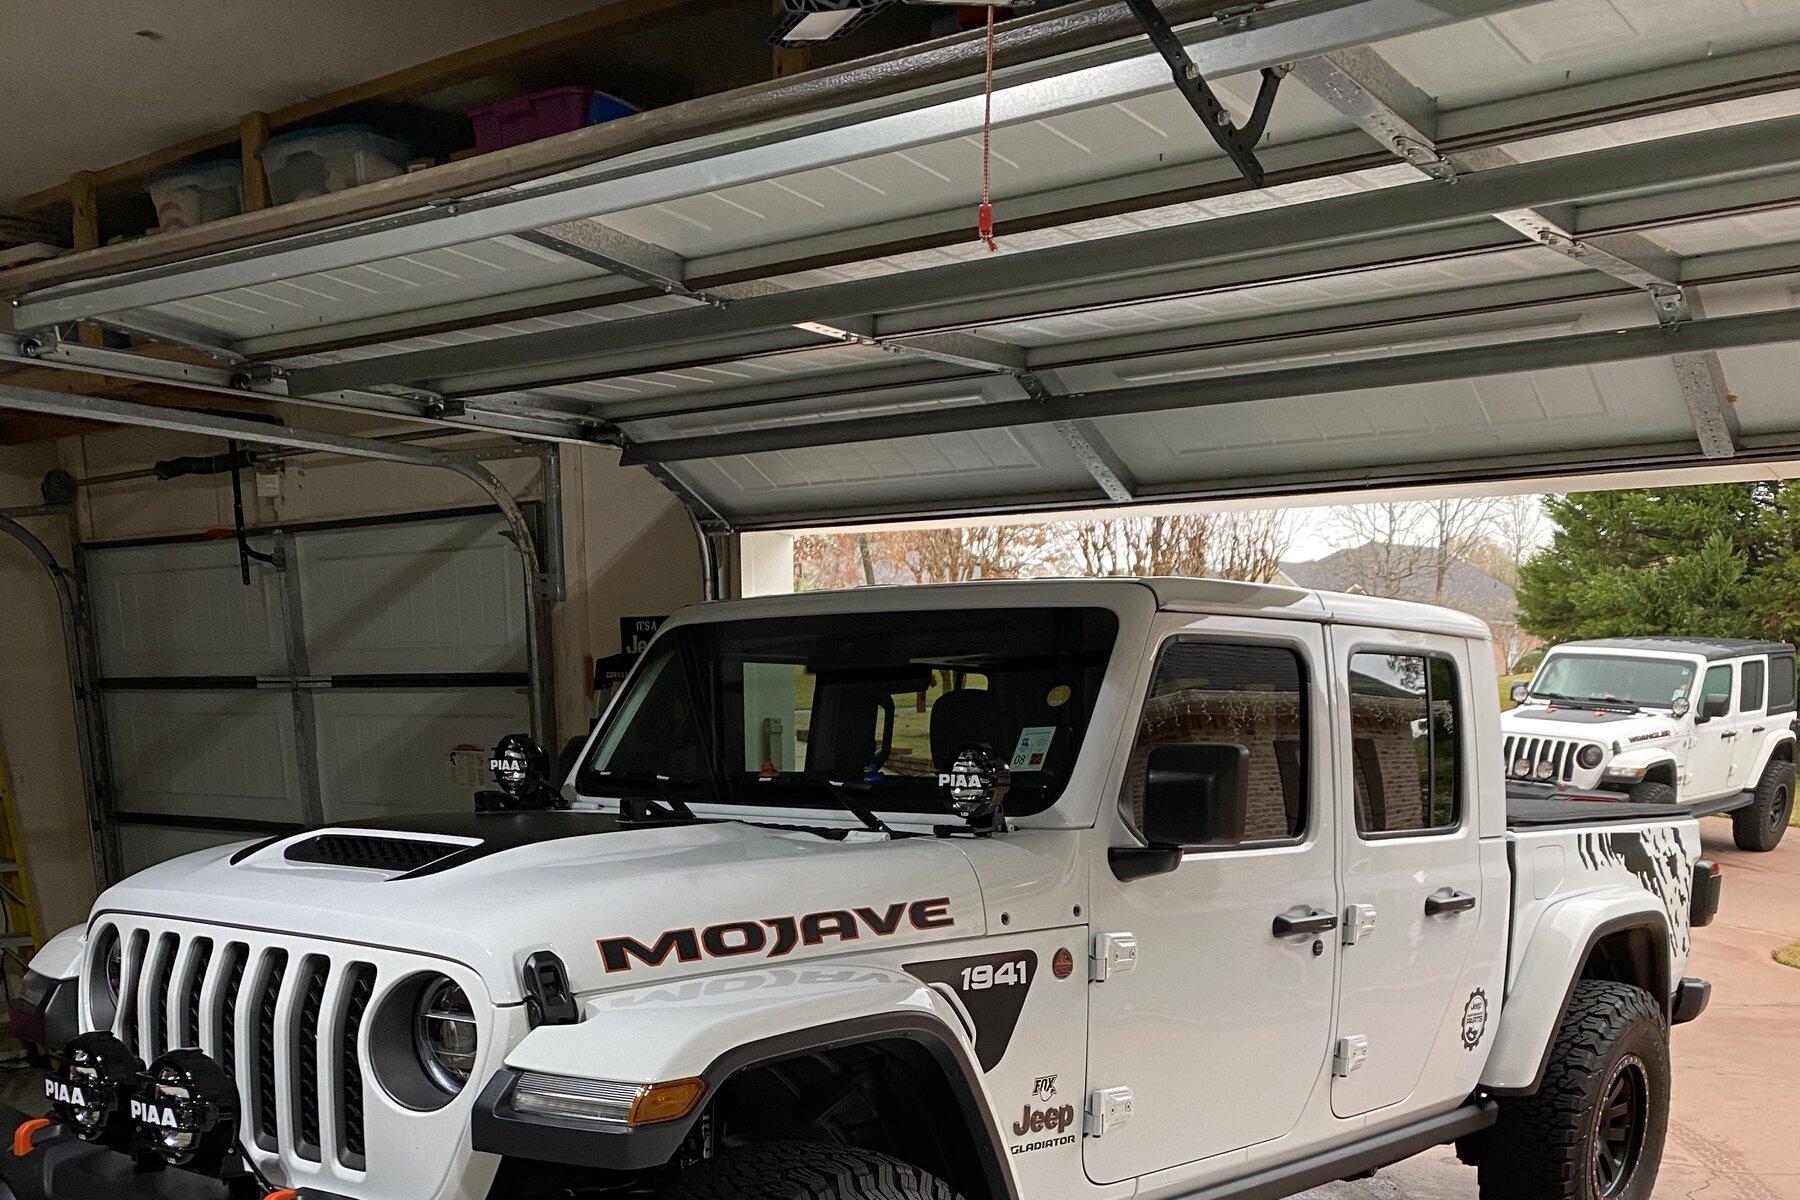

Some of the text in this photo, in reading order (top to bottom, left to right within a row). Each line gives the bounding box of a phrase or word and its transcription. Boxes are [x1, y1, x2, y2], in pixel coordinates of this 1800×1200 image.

[626, 634, 647, 654] Je
[1628, 730, 1671, 743] WRANGLER
[490, 759, 520, 770] PIAA
[938, 773, 982, 788] PIAA
[596, 896, 955, 973] MOJAVE
[960, 960, 1027, 991] 1941
[44, 1078, 86, 1107] PIAA
[130, 1100, 178, 1129] PIAA
[1012, 1104, 1074, 1136] Jeep
[1010, 1134, 1076, 1155] GLADIATOR
